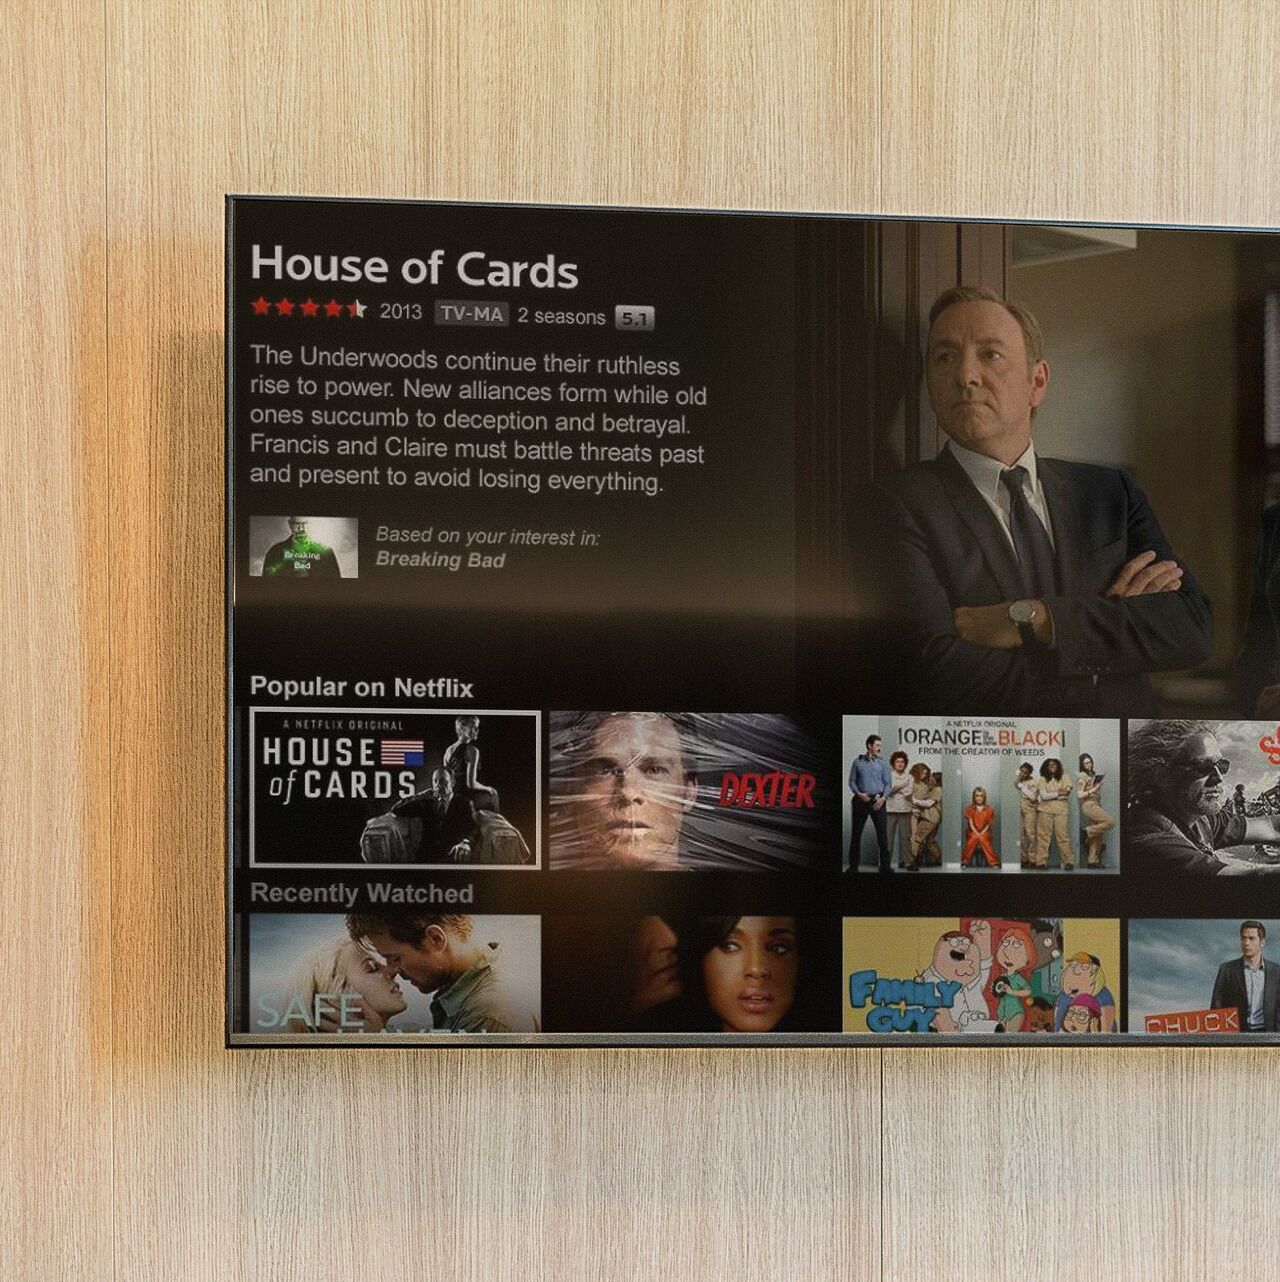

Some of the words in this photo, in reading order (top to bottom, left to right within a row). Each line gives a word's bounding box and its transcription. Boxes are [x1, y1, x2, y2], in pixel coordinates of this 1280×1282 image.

[252, 245, 388, 282] House
[402, 250, 444, 285] of
[458, 252, 579, 289] Cards
[381, 303, 422, 319] 2013
[441, 306, 503, 321] TV-MA
[518, 307, 528, 322] 2
[535, 311, 606, 325] seasons
[622, 312, 647, 326] 5.1
[250, 345, 292, 364] The
[301, 346, 437, 368] Underwoods
[446, 352, 536, 371] continue
[544, 354, 590, 372] their
[598, 356, 680, 375] ruthless
[252, 375, 289, 394] rise
[297, 377, 317, 394] to
[326, 380, 393, 400] power.
[404, 379, 451, 398] New
[459, 381, 551, 401] alliances
[560, 383, 606, 402] form
[614, 385, 668, 404] while
[676, 387, 706, 405] old
[251, 408, 303, 424] ones
[312, 408, 408, 426] succumb
[417, 409, 435, 427] to
[444, 409, 547, 434] deception
[556, 413, 594, 431] and
[603, 413, 689, 438] betrayal.
[252, 433, 329, 454] Francis
[337, 437, 376, 455] and
[386, 437, 447, 457] Claire
[456, 441, 507, 458] must
[515, 440, 572, 460] battle
[580, 442, 652, 462] threats
[660, 446, 704, 467] past
[250, 464, 290, 482] and
[300, 467, 379, 490] present
[387, 467, 406, 485] to
[415, 468, 470, 487] avoid
[480, 469, 540, 493] losing
[549, 472, 663, 496] everything.
[376, 526, 432, 542] Based
[439, 531, 460, 543] on
[466, 531, 506, 550] your
[510, 529, 575, 545] interest
[581, 530, 600, 545] in:
[376, 551, 461, 571] Breaking
[468, 553, 505, 568] Bad
[251, 675, 347, 700] Popular
[354, 680, 385, 697] on
[395, 677, 474, 698] Netflix
[283, 720, 289, 728] A
[295, 720, 343, 730] NETFLIX
[348, 720, 403, 731] ORIGINAL
[904, 728, 982, 746] ORANGE
[999, 730, 1060, 747] BLACK
[263, 737, 375, 766] HOUSE
[270, 769, 297, 805] of
[304, 769, 416, 799] CARDS
[719, 772, 816, 810] DEXTER
[251, 883, 359, 909] Recently
[368, 884, 474, 903] Watched
[849, 970, 963, 1008] FAMILY
[257, 993, 364, 1028] SAFE
[866, 1007, 938, 1033] GUY
[1145, 1010, 1239, 1033] CHUCK
